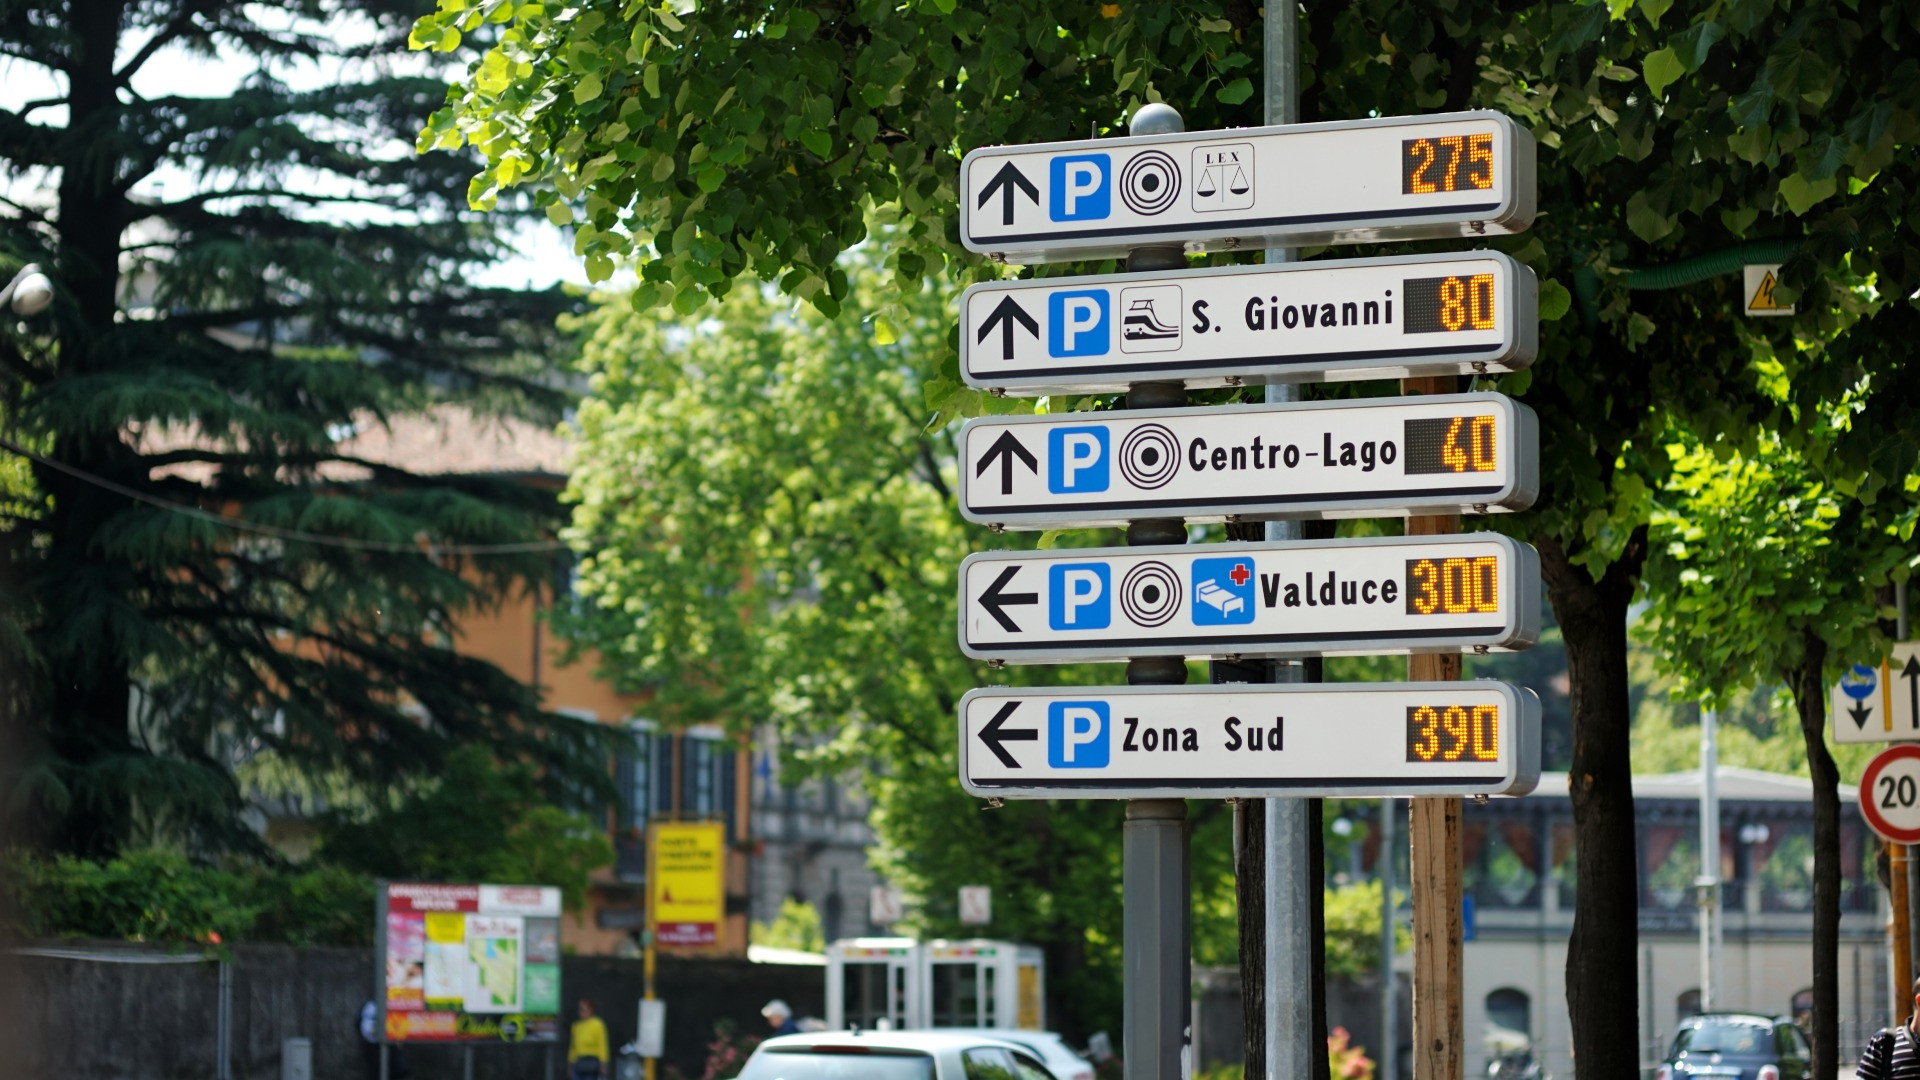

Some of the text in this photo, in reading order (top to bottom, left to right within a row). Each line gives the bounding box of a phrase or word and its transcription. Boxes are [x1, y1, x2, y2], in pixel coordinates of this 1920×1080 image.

[1206, 151, 1240, 164] LEX
[1411, 133, 1493, 194] 275
[1064, 161, 1103, 215] P
[1064, 289, 1393, 351] P S. Giovanni
[1441, 274, 1495, 332] 80
[1064, 432, 1397, 487] P Centro-Lago
[1443, 415, 1497, 473] 40
[1065, 570, 1398, 625] P Valduce
[1414, 557, 1498, 614] 300
[1064, 708, 1284, 762] P Zona Sud
[1415, 705, 1499, 761] 390
[1879, 775, 1917, 809] 20
